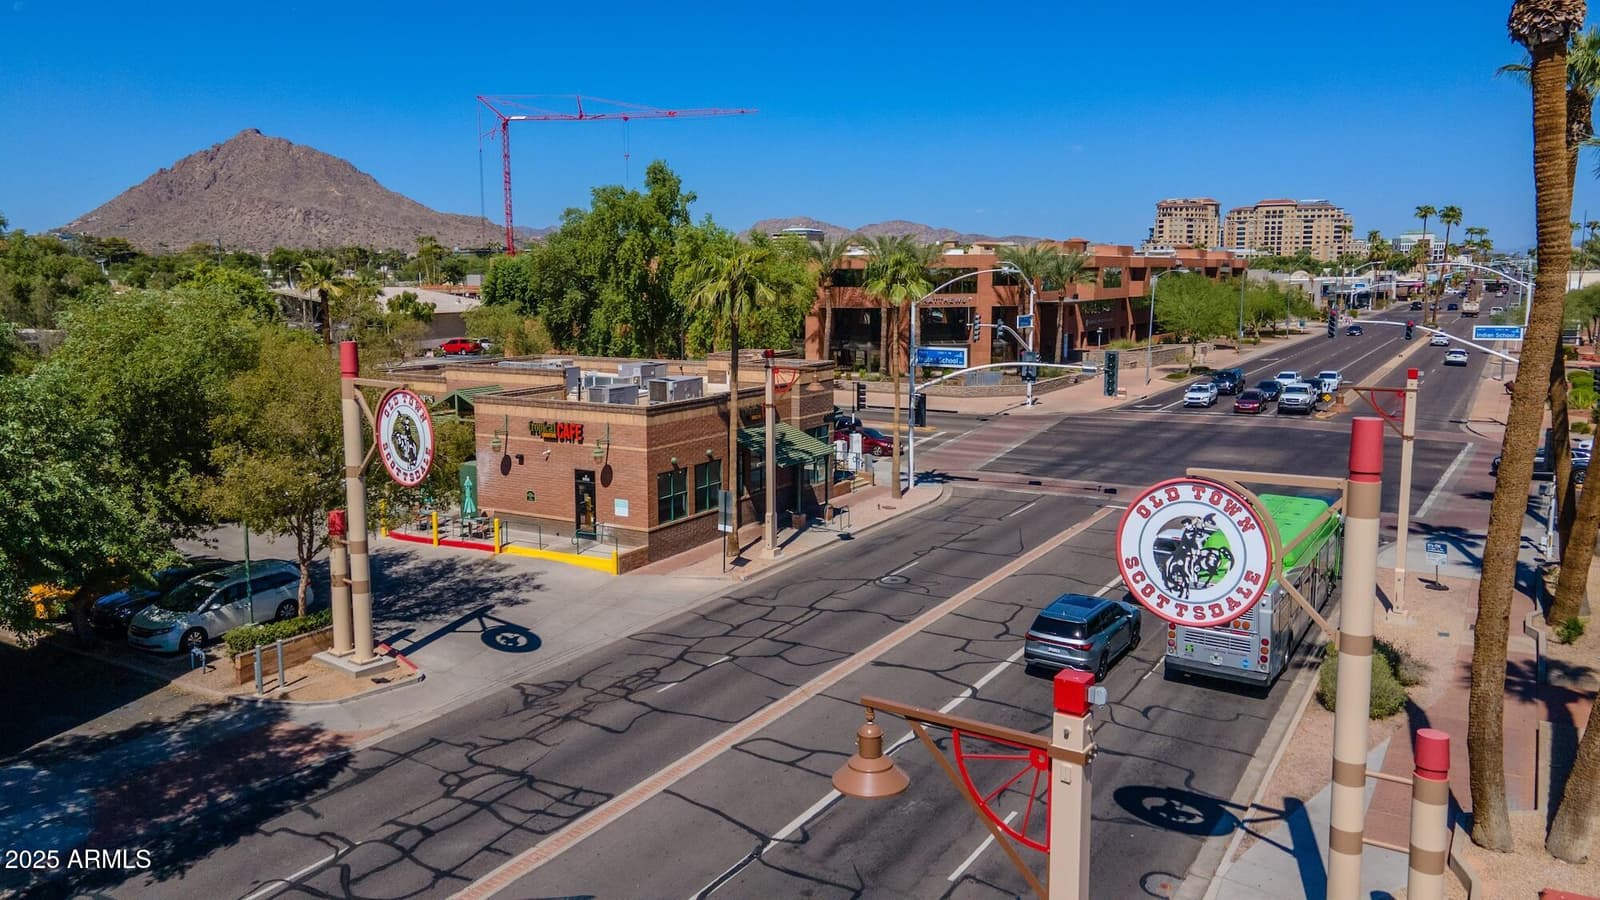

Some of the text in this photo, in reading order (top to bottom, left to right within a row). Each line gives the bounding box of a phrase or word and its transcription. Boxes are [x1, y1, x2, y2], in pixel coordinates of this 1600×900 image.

[384, 394, 427, 423] OLD TOWN
[557, 421, 582, 441] CAFE
[382, 442, 431, 482] SCOTTSDALE
[1136, 485, 1256, 533] OLD TOWN
[1124, 556, 1262, 620] SCOTTSDALE
